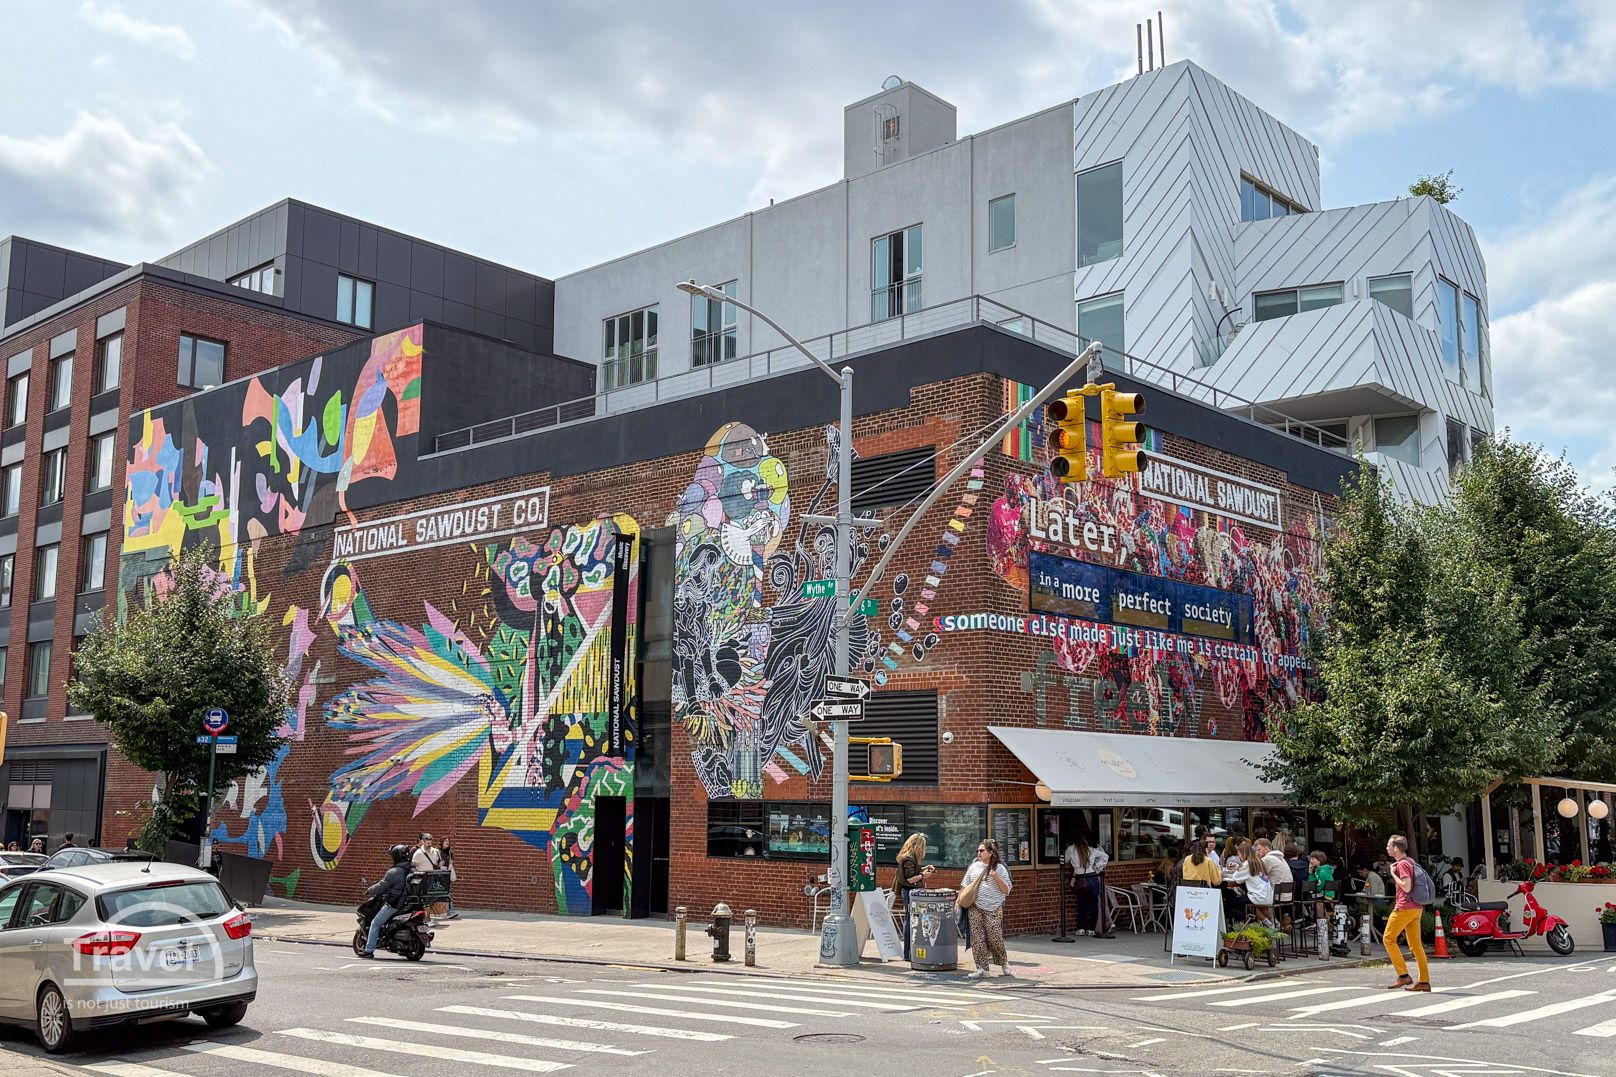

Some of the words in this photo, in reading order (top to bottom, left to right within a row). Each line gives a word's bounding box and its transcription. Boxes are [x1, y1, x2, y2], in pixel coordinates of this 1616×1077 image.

[1143, 460, 1215, 505] NATIONAL
[1217, 480, 1275, 521] SAWDUST
[336, 522, 407, 556] NATIONAL
[415, 504, 501, 542] SAWDUST
[513, 497, 543, 525] CO.
[1030, 497, 1128, 565] Later,
[806, 583, 826, 597] Wythe
[827, 580, 834, 589] Av
[860, 600, 866, 612] 6
[1039, 571, 1051, 587] in
[1053, 576, 1060, 588] a
[1062, 582, 1100, 604] more
[1118, 592, 1172, 616] perfect
[943, 612, 1025, 633] someone
[1031, 614, 1066, 640] else
[1070, 624, 1107, 644] made
[1110, 624, 1140, 649] just
[1145, 633, 1172, 652] like
[1176, 638, 1194, 654] me
[1198, 637, 1211, 656] is
[1214, 643, 1259, 664] certain
[1261, 652, 1275, 666] to
[613, 657, 621, 703] SAWDUST
[828, 681, 843, 692] ONE
[849, 683, 865, 694] WAY
[612, 703, 620, 749] NATIONAL
[816, 706, 832, 715] ONE
[841, 705, 859, 714] WAY
